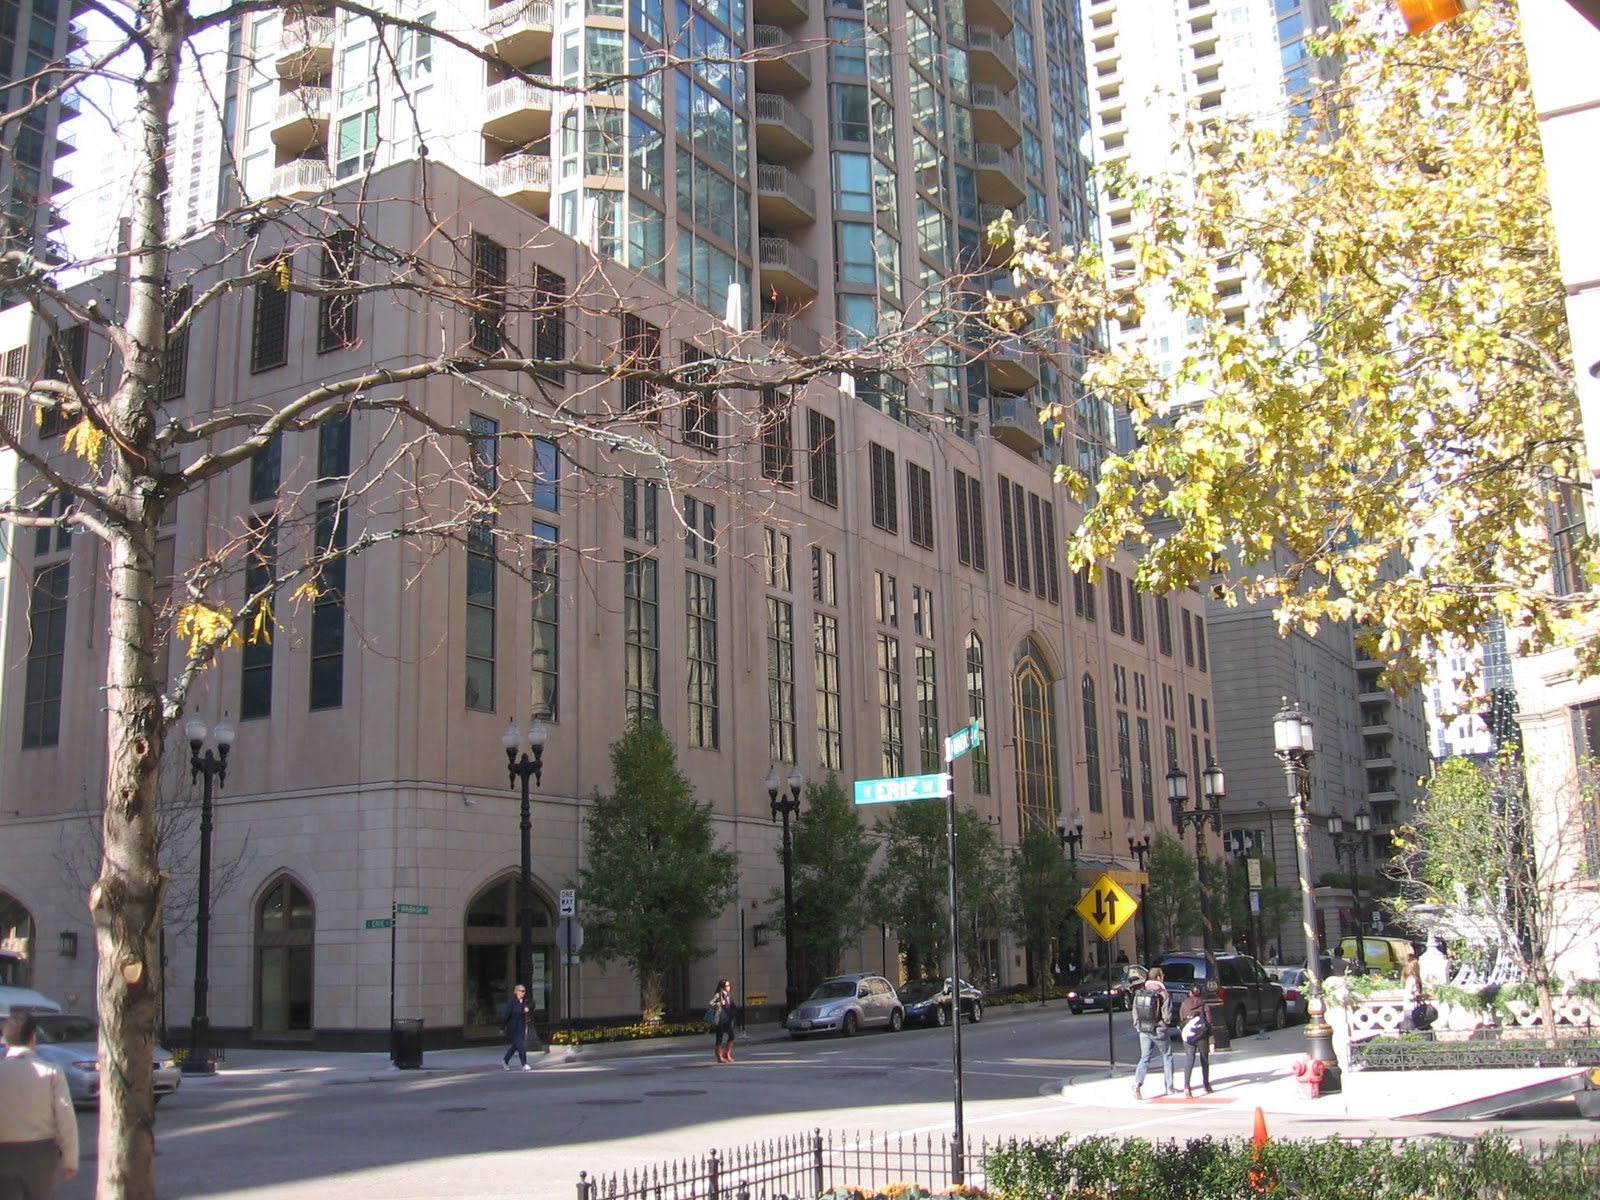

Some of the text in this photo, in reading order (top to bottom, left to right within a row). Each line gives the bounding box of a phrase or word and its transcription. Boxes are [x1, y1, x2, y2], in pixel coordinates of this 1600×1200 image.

[875, 779, 918, 800] ERIE
[561, 890, 574, 898] ONE
[371, 920, 385, 928] ERIE
